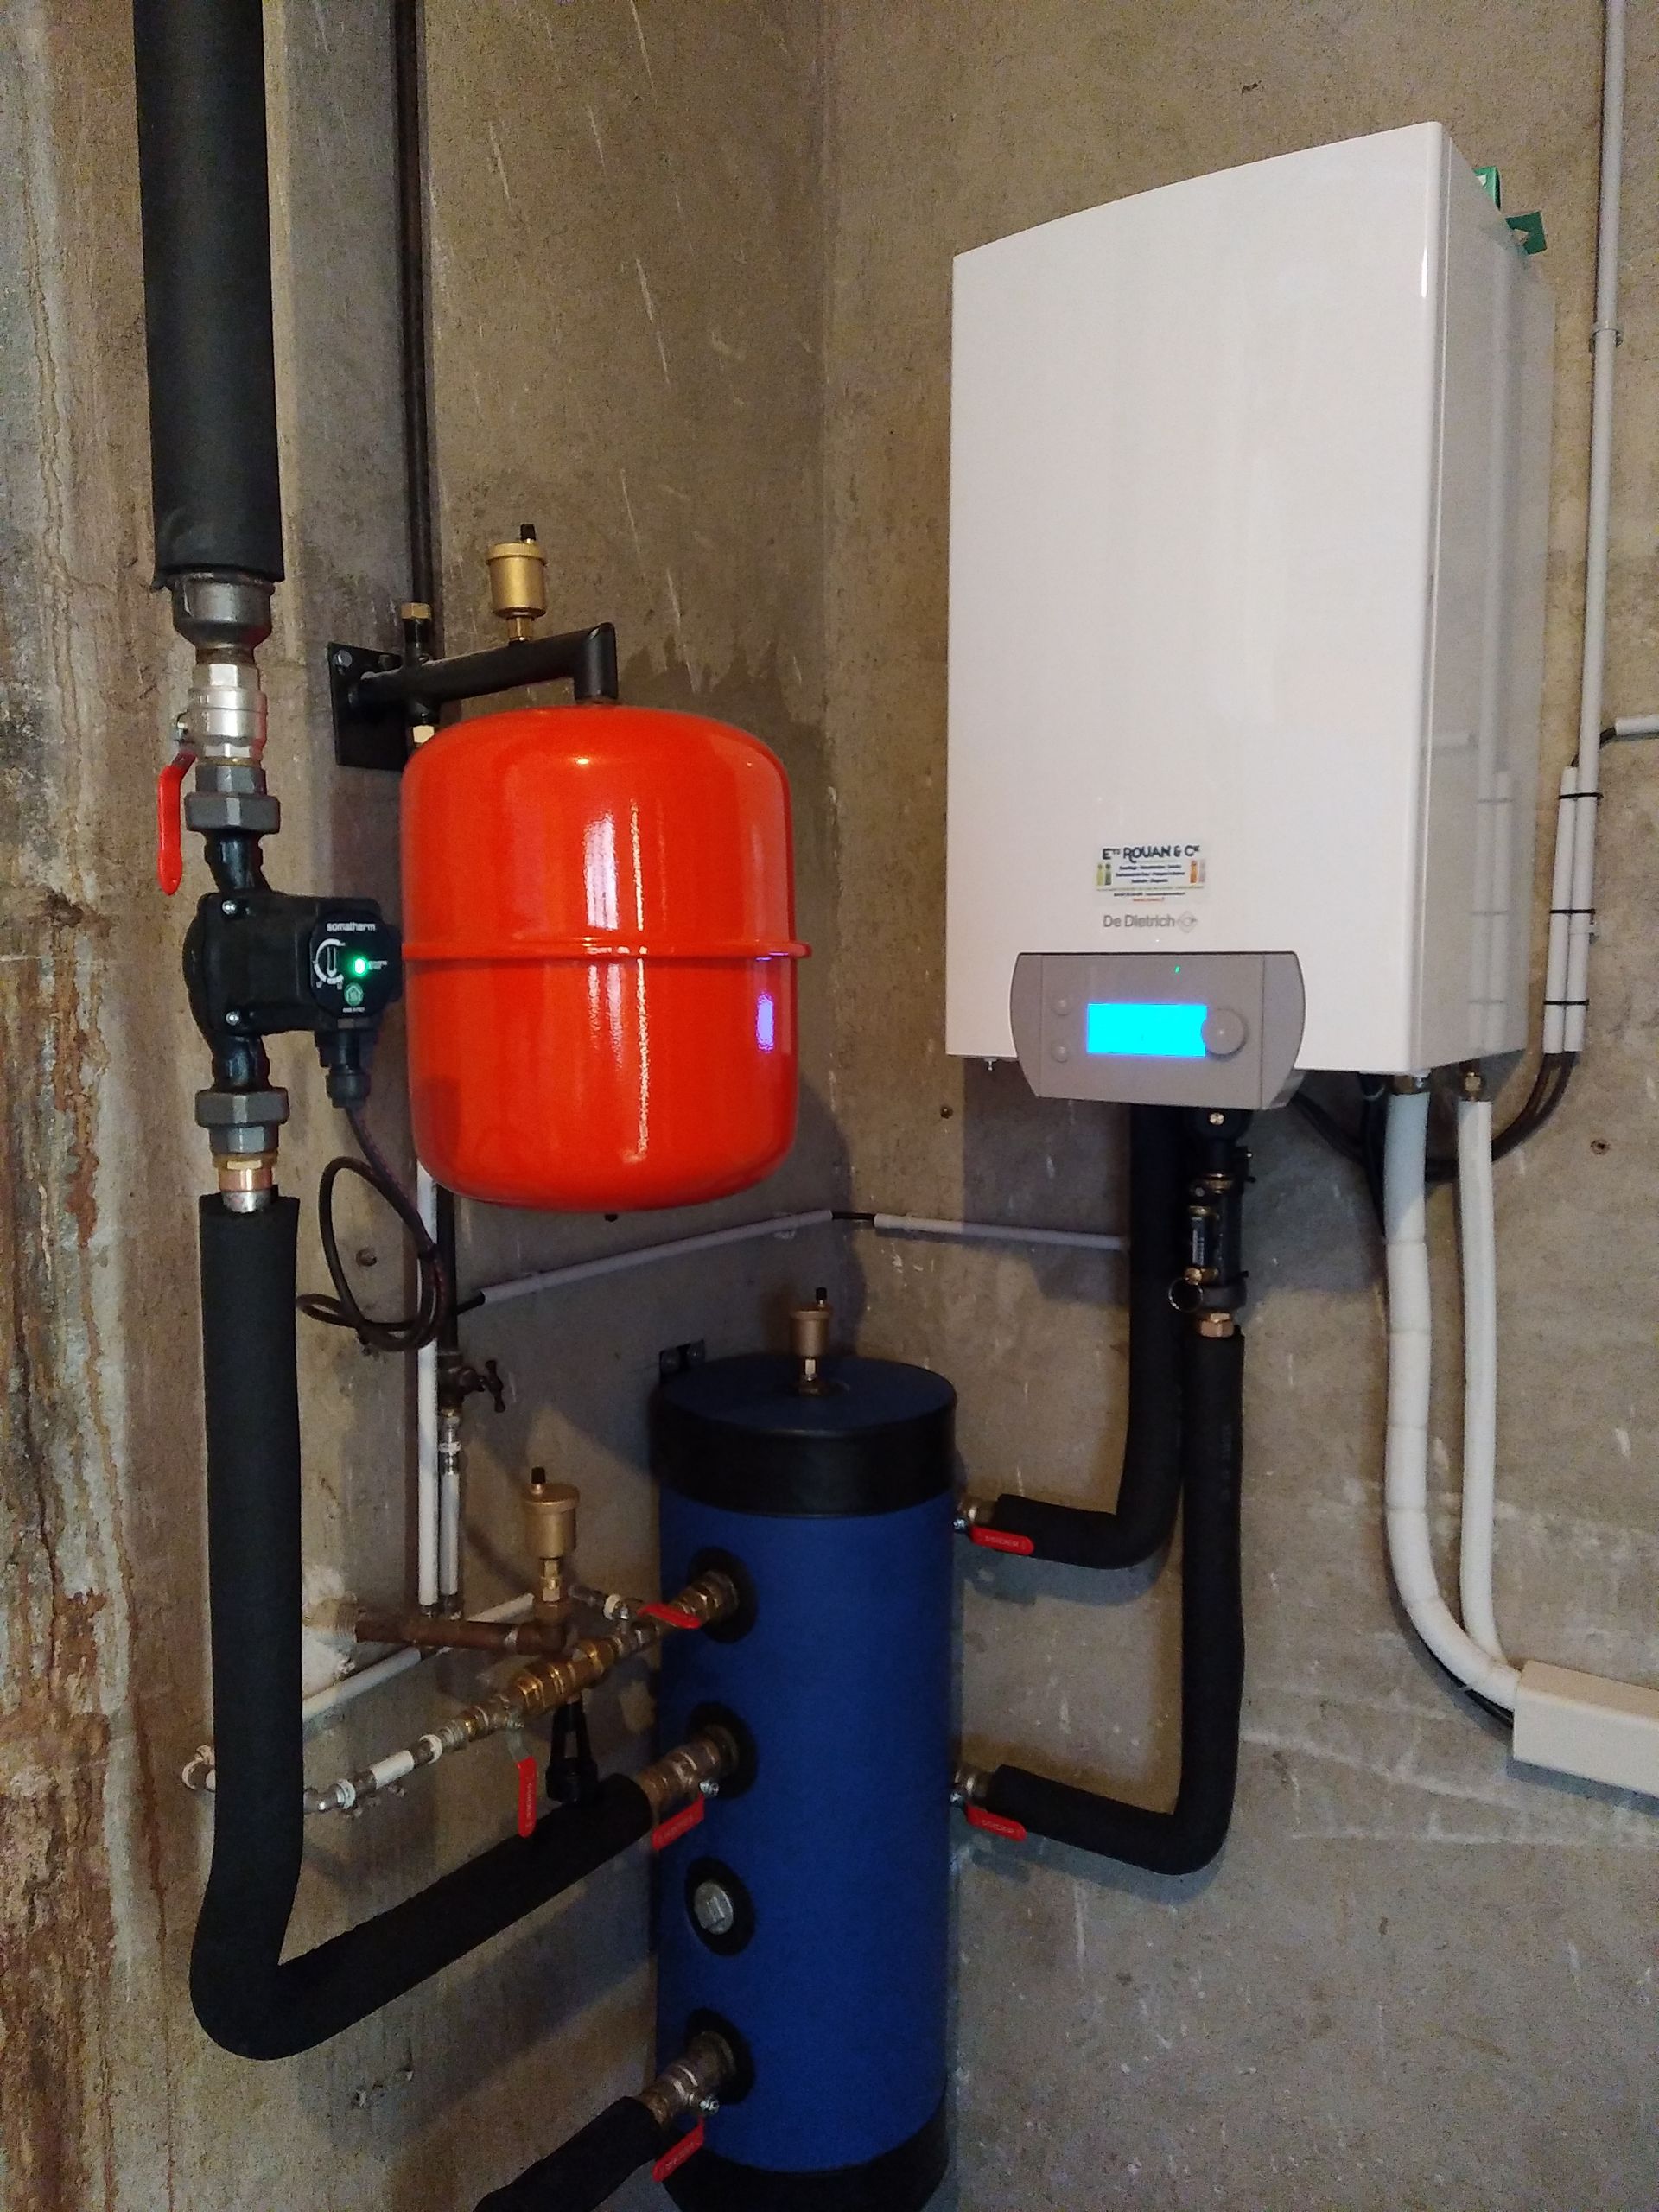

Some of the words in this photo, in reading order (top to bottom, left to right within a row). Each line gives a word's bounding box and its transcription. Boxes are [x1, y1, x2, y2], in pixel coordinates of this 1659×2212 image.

[1123, 845, 1172, 863] ROUAN
[327, 921, 376, 932] somatherm
[1103, 914, 1122, 928] De
[1124, 914, 1176, 928] Dietrich
